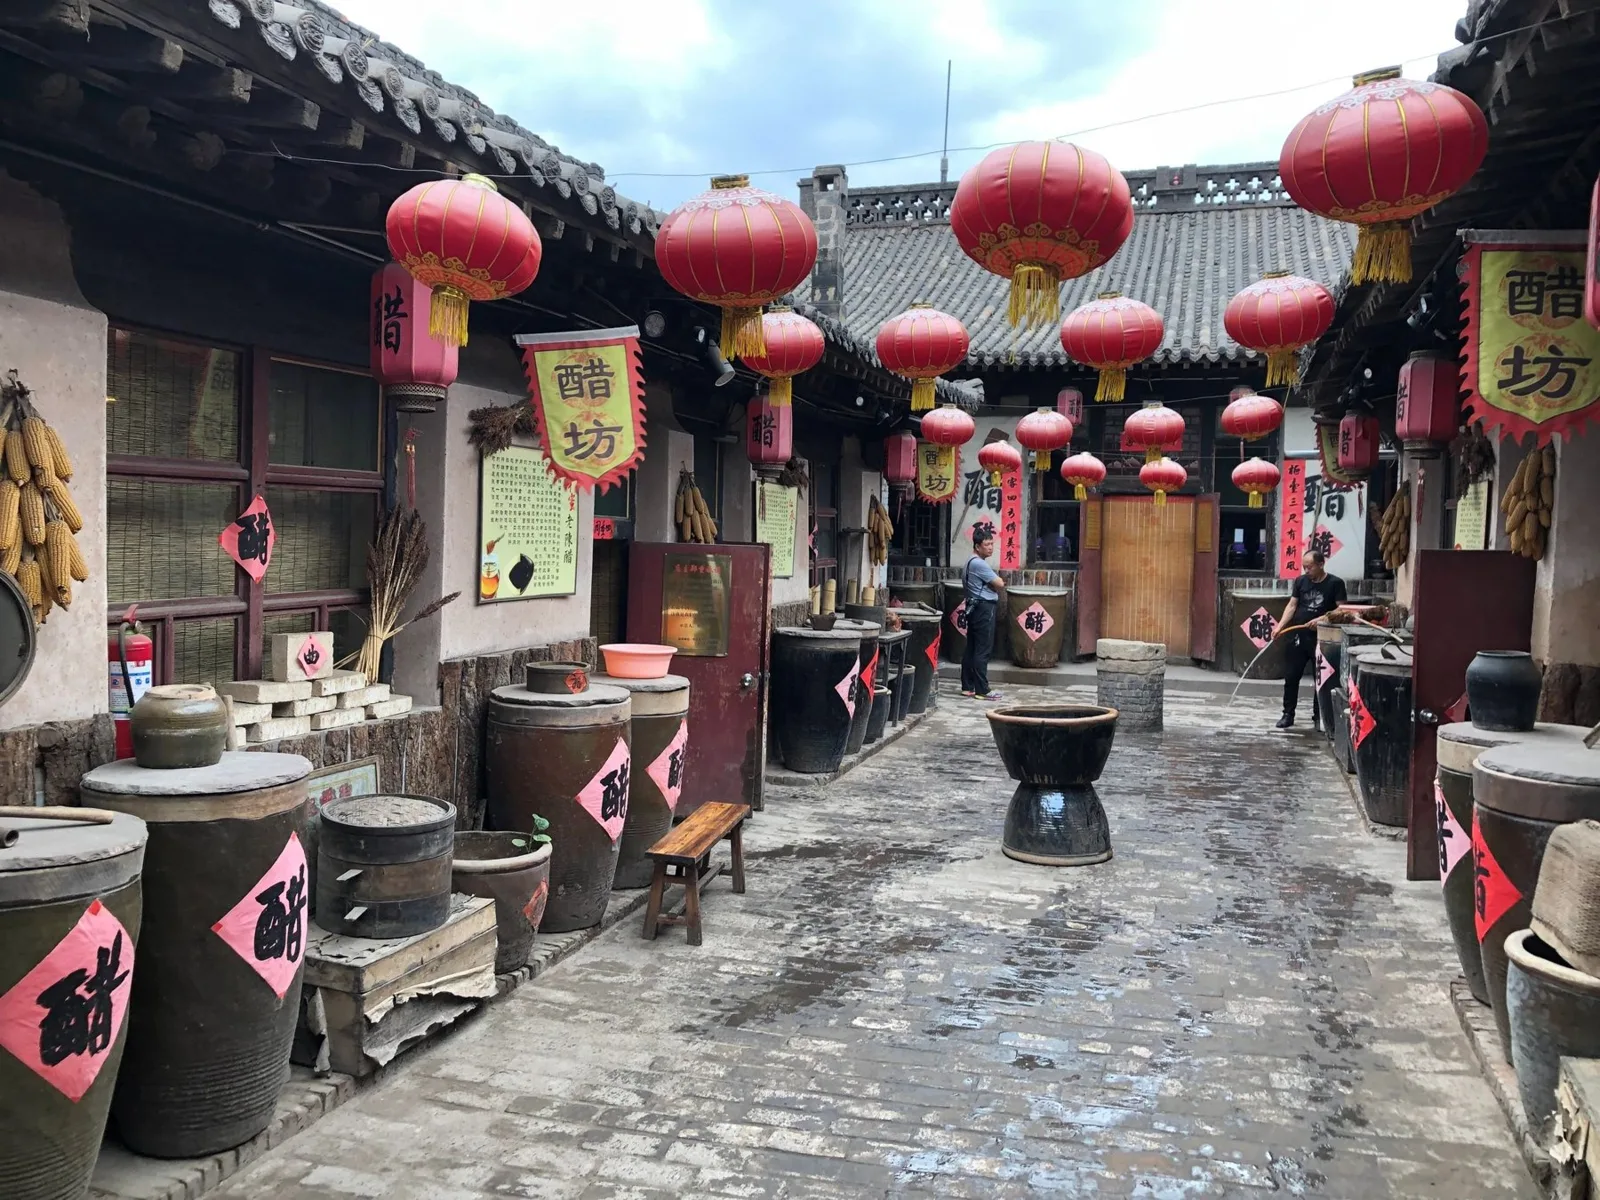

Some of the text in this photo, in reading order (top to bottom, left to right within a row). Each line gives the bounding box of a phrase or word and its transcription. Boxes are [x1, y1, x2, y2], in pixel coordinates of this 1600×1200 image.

[751, 413, 777, 448] 醋
[236, 510, 272, 567] 醋
[1025, 606, 1047, 633] 醋
[1249, 613, 1274, 642] 醋
[254, 863, 307, 963] 醋
[36, 929, 130, 1066] 醋
